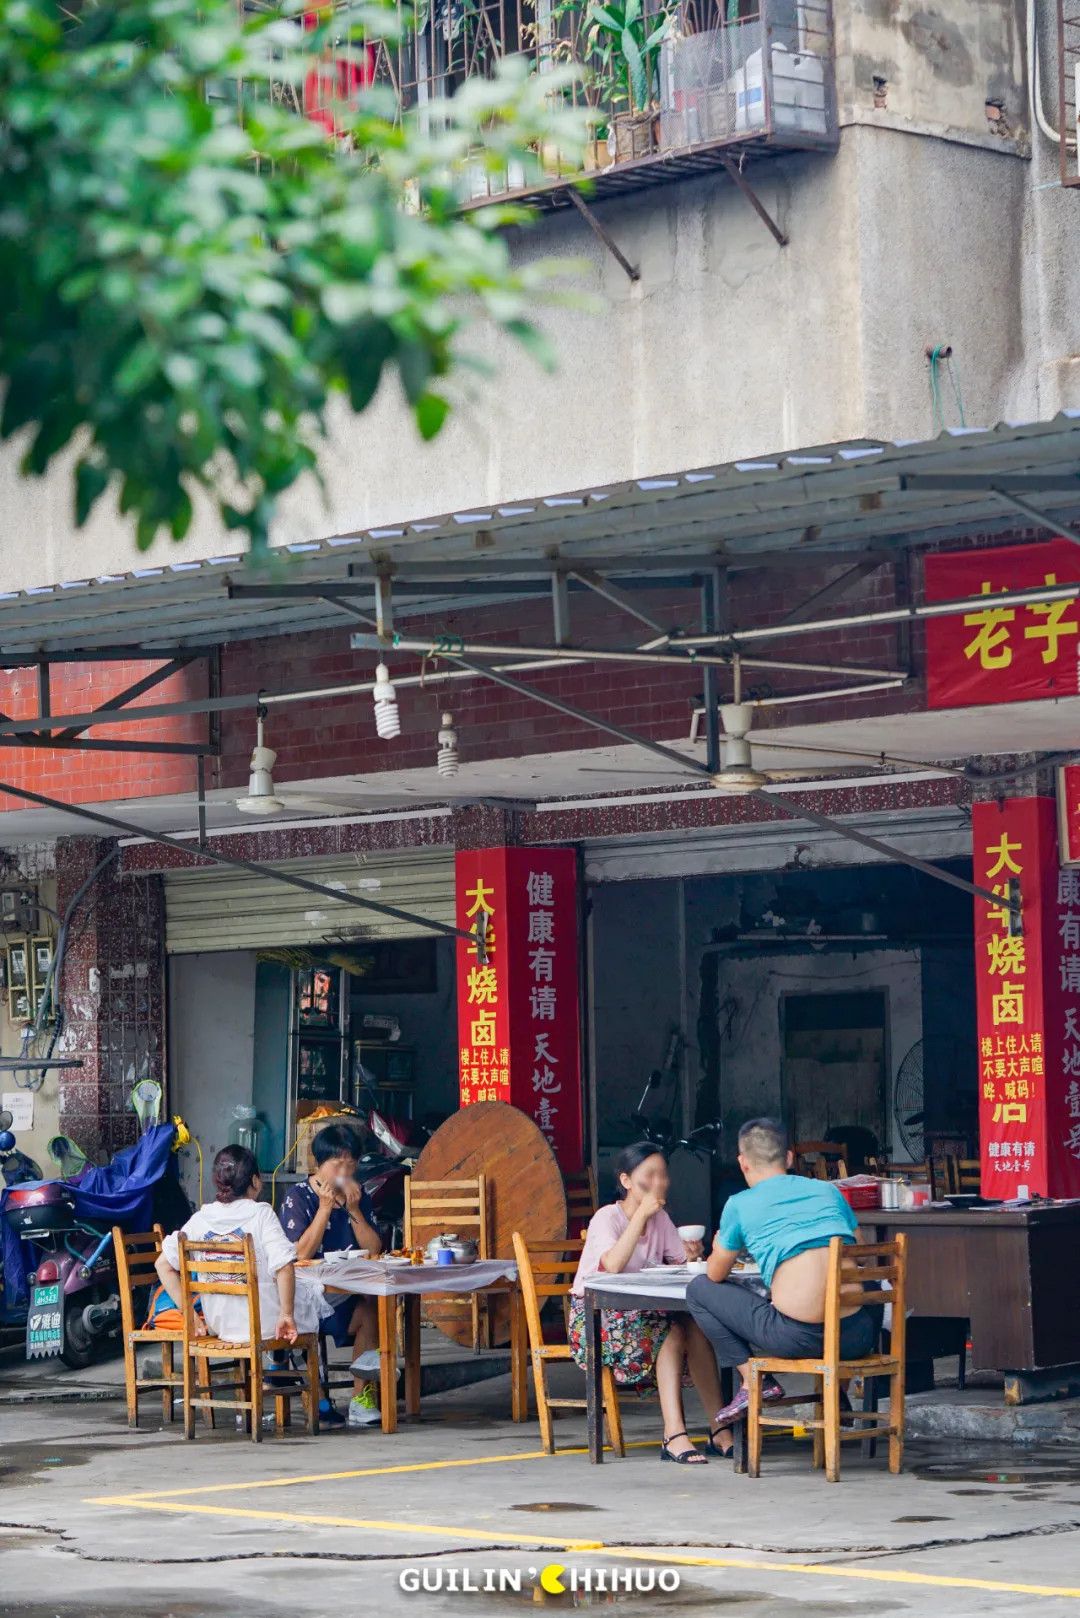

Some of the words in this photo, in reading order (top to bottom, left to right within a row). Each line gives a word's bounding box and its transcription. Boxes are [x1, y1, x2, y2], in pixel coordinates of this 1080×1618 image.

[963, 573, 1078, 670] 老字
[526, 871, 557, 1021] 健康有请
[461, 1048, 509, 1066] 楼上住人请
[981, 1033, 1042, 1057] 楼上住人请
[461, 1068, 509, 1086] 不要大声喧
[983, 1056, 1044, 1080] 不要大声喧
[532, 1033, 562, 1150] 天地壹
[988, 1141, 1036, 1157] 健康有请
[994, 1160, 1031, 1172] 天地壹号
